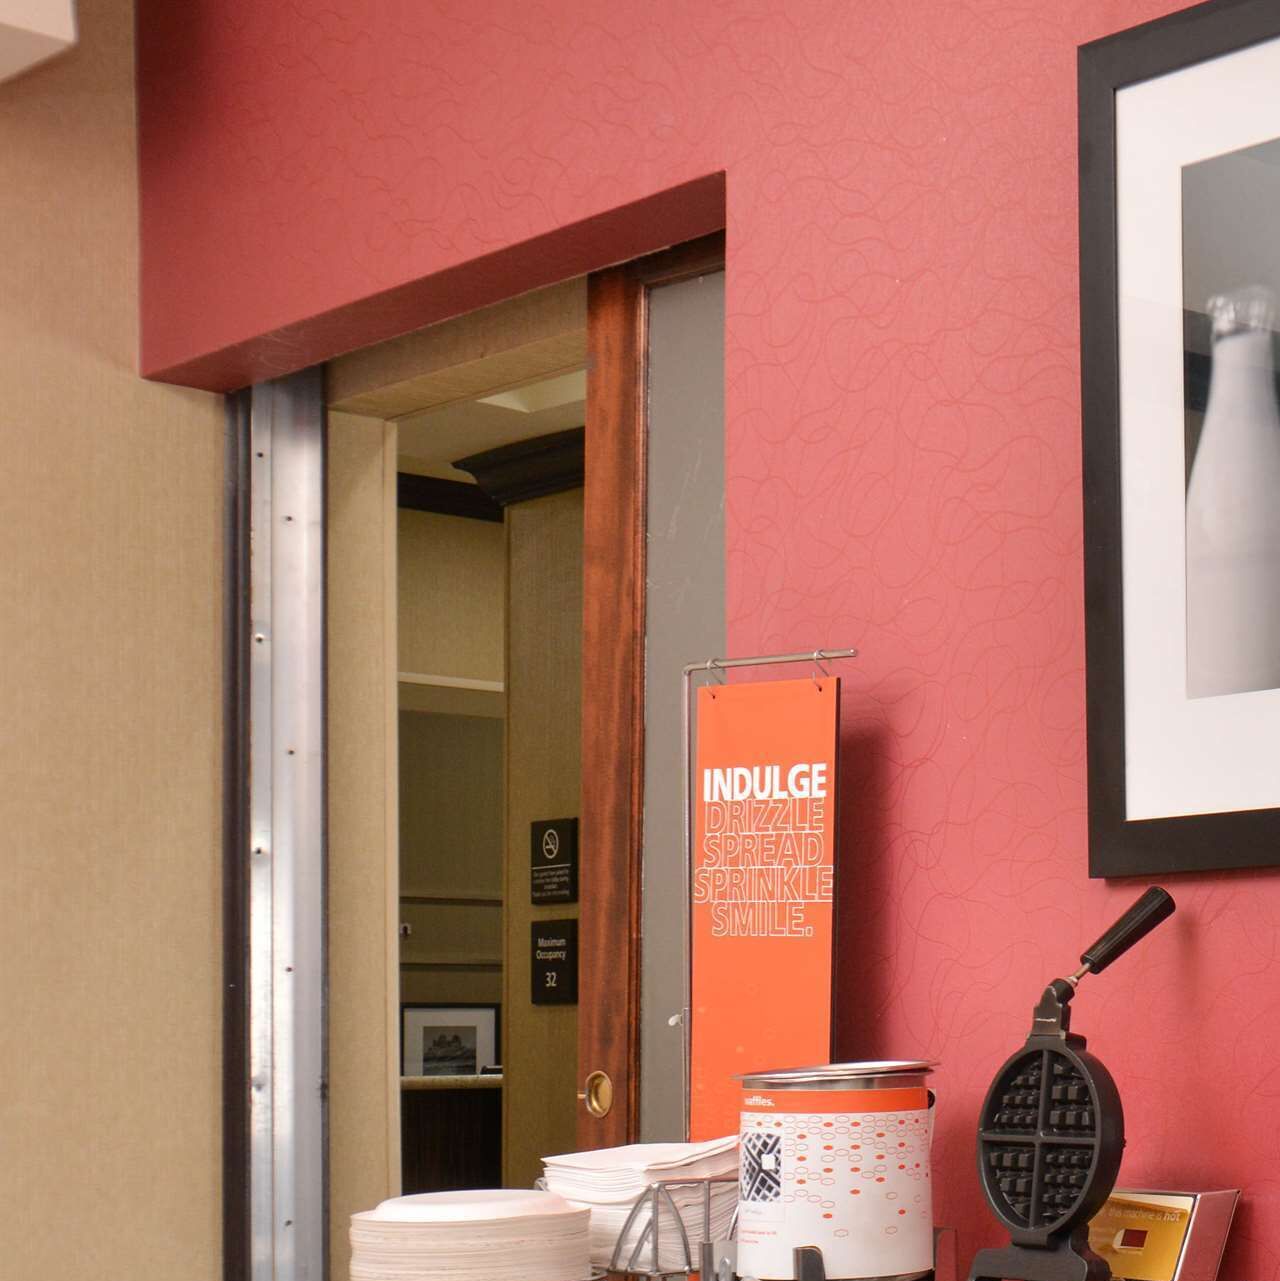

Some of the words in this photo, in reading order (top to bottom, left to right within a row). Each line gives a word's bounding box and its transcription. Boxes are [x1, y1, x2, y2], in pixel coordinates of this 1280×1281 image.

[703, 763, 828, 802] INDULGE
[704, 798, 825, 834] DRIZZLE
[703, 832, 825, 868] SPREAD
[694, 866, 833, 903] SPRINKLE
[711, 901, 814, 937] SMILE.
[545, 972, 557, 987] 32
